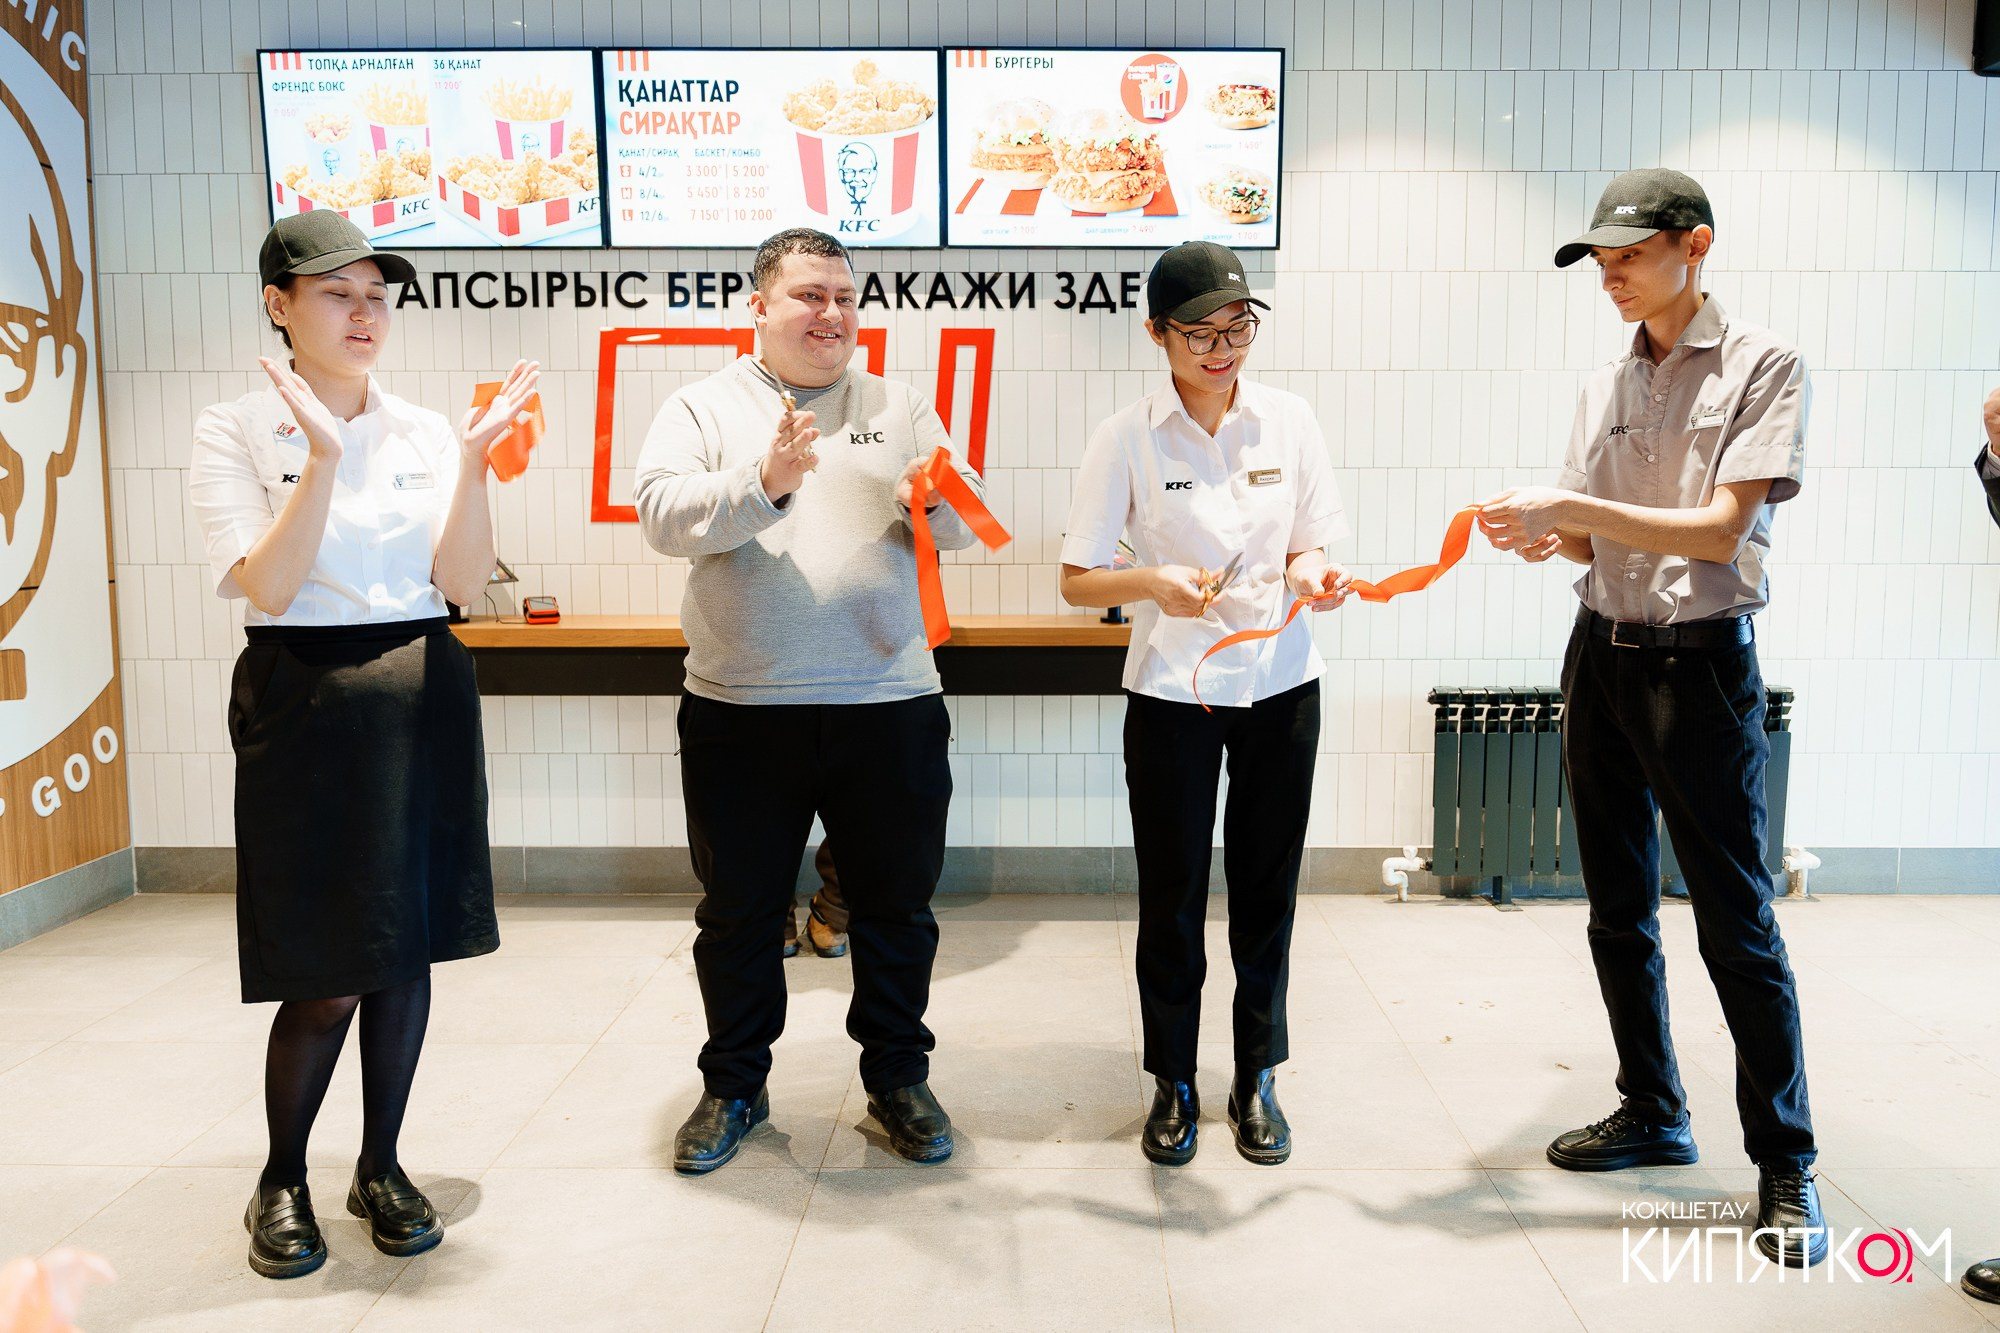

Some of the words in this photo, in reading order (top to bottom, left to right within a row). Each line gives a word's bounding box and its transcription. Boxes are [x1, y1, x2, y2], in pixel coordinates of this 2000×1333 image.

[307, 58, 348, 73] ТОПҚА
[352, 58, 414, 70] АРНАЛҒАН
[433, 59, 445, 70] 36
[448, 58, 482, 73] ҚАНАТ
[995, 56, 1054, 69] БУРГЕРЫ
[272, 81, 316, 94] ФРЕНДС
[319, 81, 346, 92] БОКС
[618, 80, 739, 107] ҚАНАТТАР
[619, 111, 741, 140] СИРАҚТАР
[402, 198, 430, 216] KFC
[577, 196, 601, 214] KF
[838, 219, 880, 232] KFC
[395, 271, 648, 309] АПСЫРЫС
[668, 271, 756, 309] БЕР
[857, 271, 1036, 310] АКАЖИ
[1053, 271, 1141, 313] ЗДЕ
[849, 431, 885, 445] KFC
[1610, 425, 1629, 436] KFC
[1165, 481, 1192, 491] KFC
